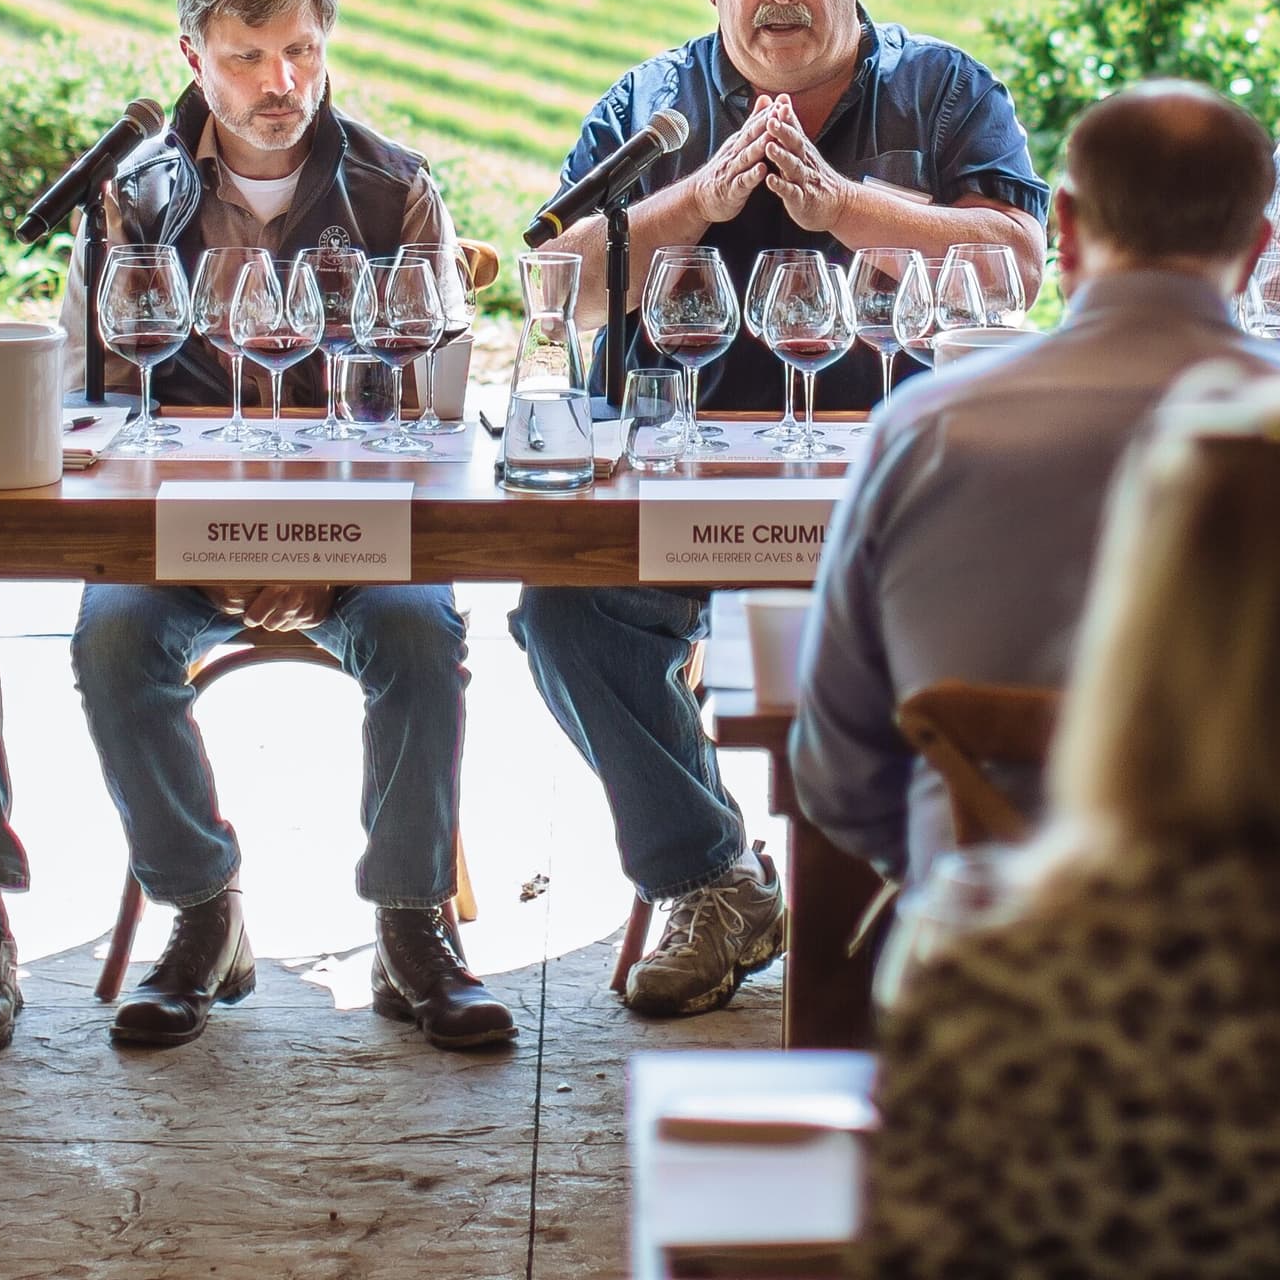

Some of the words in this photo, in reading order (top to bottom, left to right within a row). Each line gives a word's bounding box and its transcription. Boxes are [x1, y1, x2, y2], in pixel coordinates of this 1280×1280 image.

[207, 523, 269, 542] STEVE
[276, 523, 362, 542] URBERG
[692, 525, 745, 544] MIKE
[752, 524, 830, 544] CRUML
[182, 551, 226, 563] GLORIA
[229, 552, 268, 563] FERRER
[271, 552, 310, 564] CAVES
[312, 553, 321, 564] &
[324, 552, 387, 564] VINEYARDS
[665, 551, 709, 564] GLORIA
[712, 552, 751, 564] FERRER
[754, 552, 793, 564] CAVES
[795, 553, 805, 564] &
